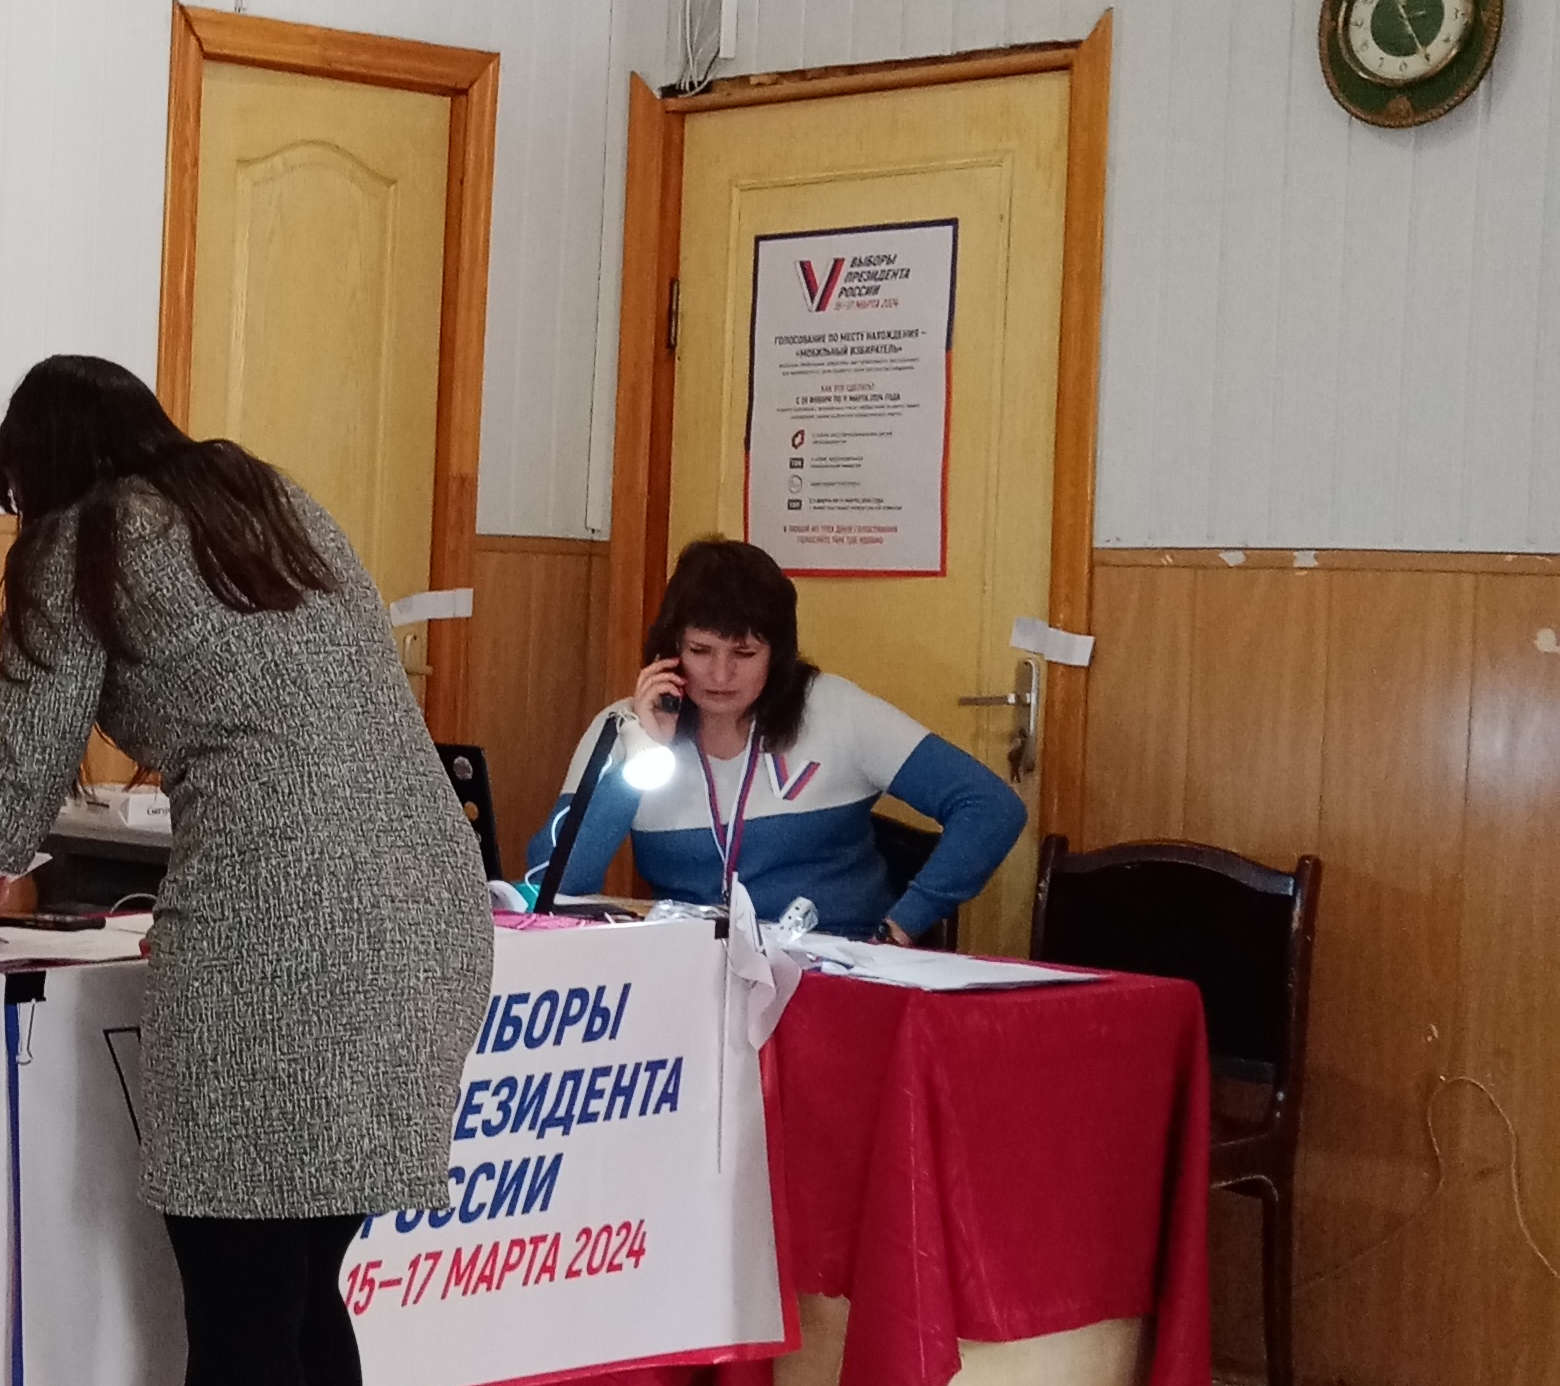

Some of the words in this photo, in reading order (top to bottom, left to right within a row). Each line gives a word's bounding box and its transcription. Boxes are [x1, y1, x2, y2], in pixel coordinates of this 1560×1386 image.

[850, 253, 898, 268] ВЫБОРЫ
[844, 268, 911, 284] ПРЕЗИДЕНТА
[838, 284, 882, 299] РОССИИ
[774, 333, 826, 345] ГОЛОСОВАНИЕ
[841, 331, 865, 343] МЕСТУ
[866, 328, 920, 341] НАХОЖДЕНИЯ
[476, 982, 632, 1055] БОРЫ
[453, 1056, 684, 1141] ЕЗИДЕНТА
[441, 1232, 561, 1301] МАРТА
[565, 1218, 647, 1280] 2024
